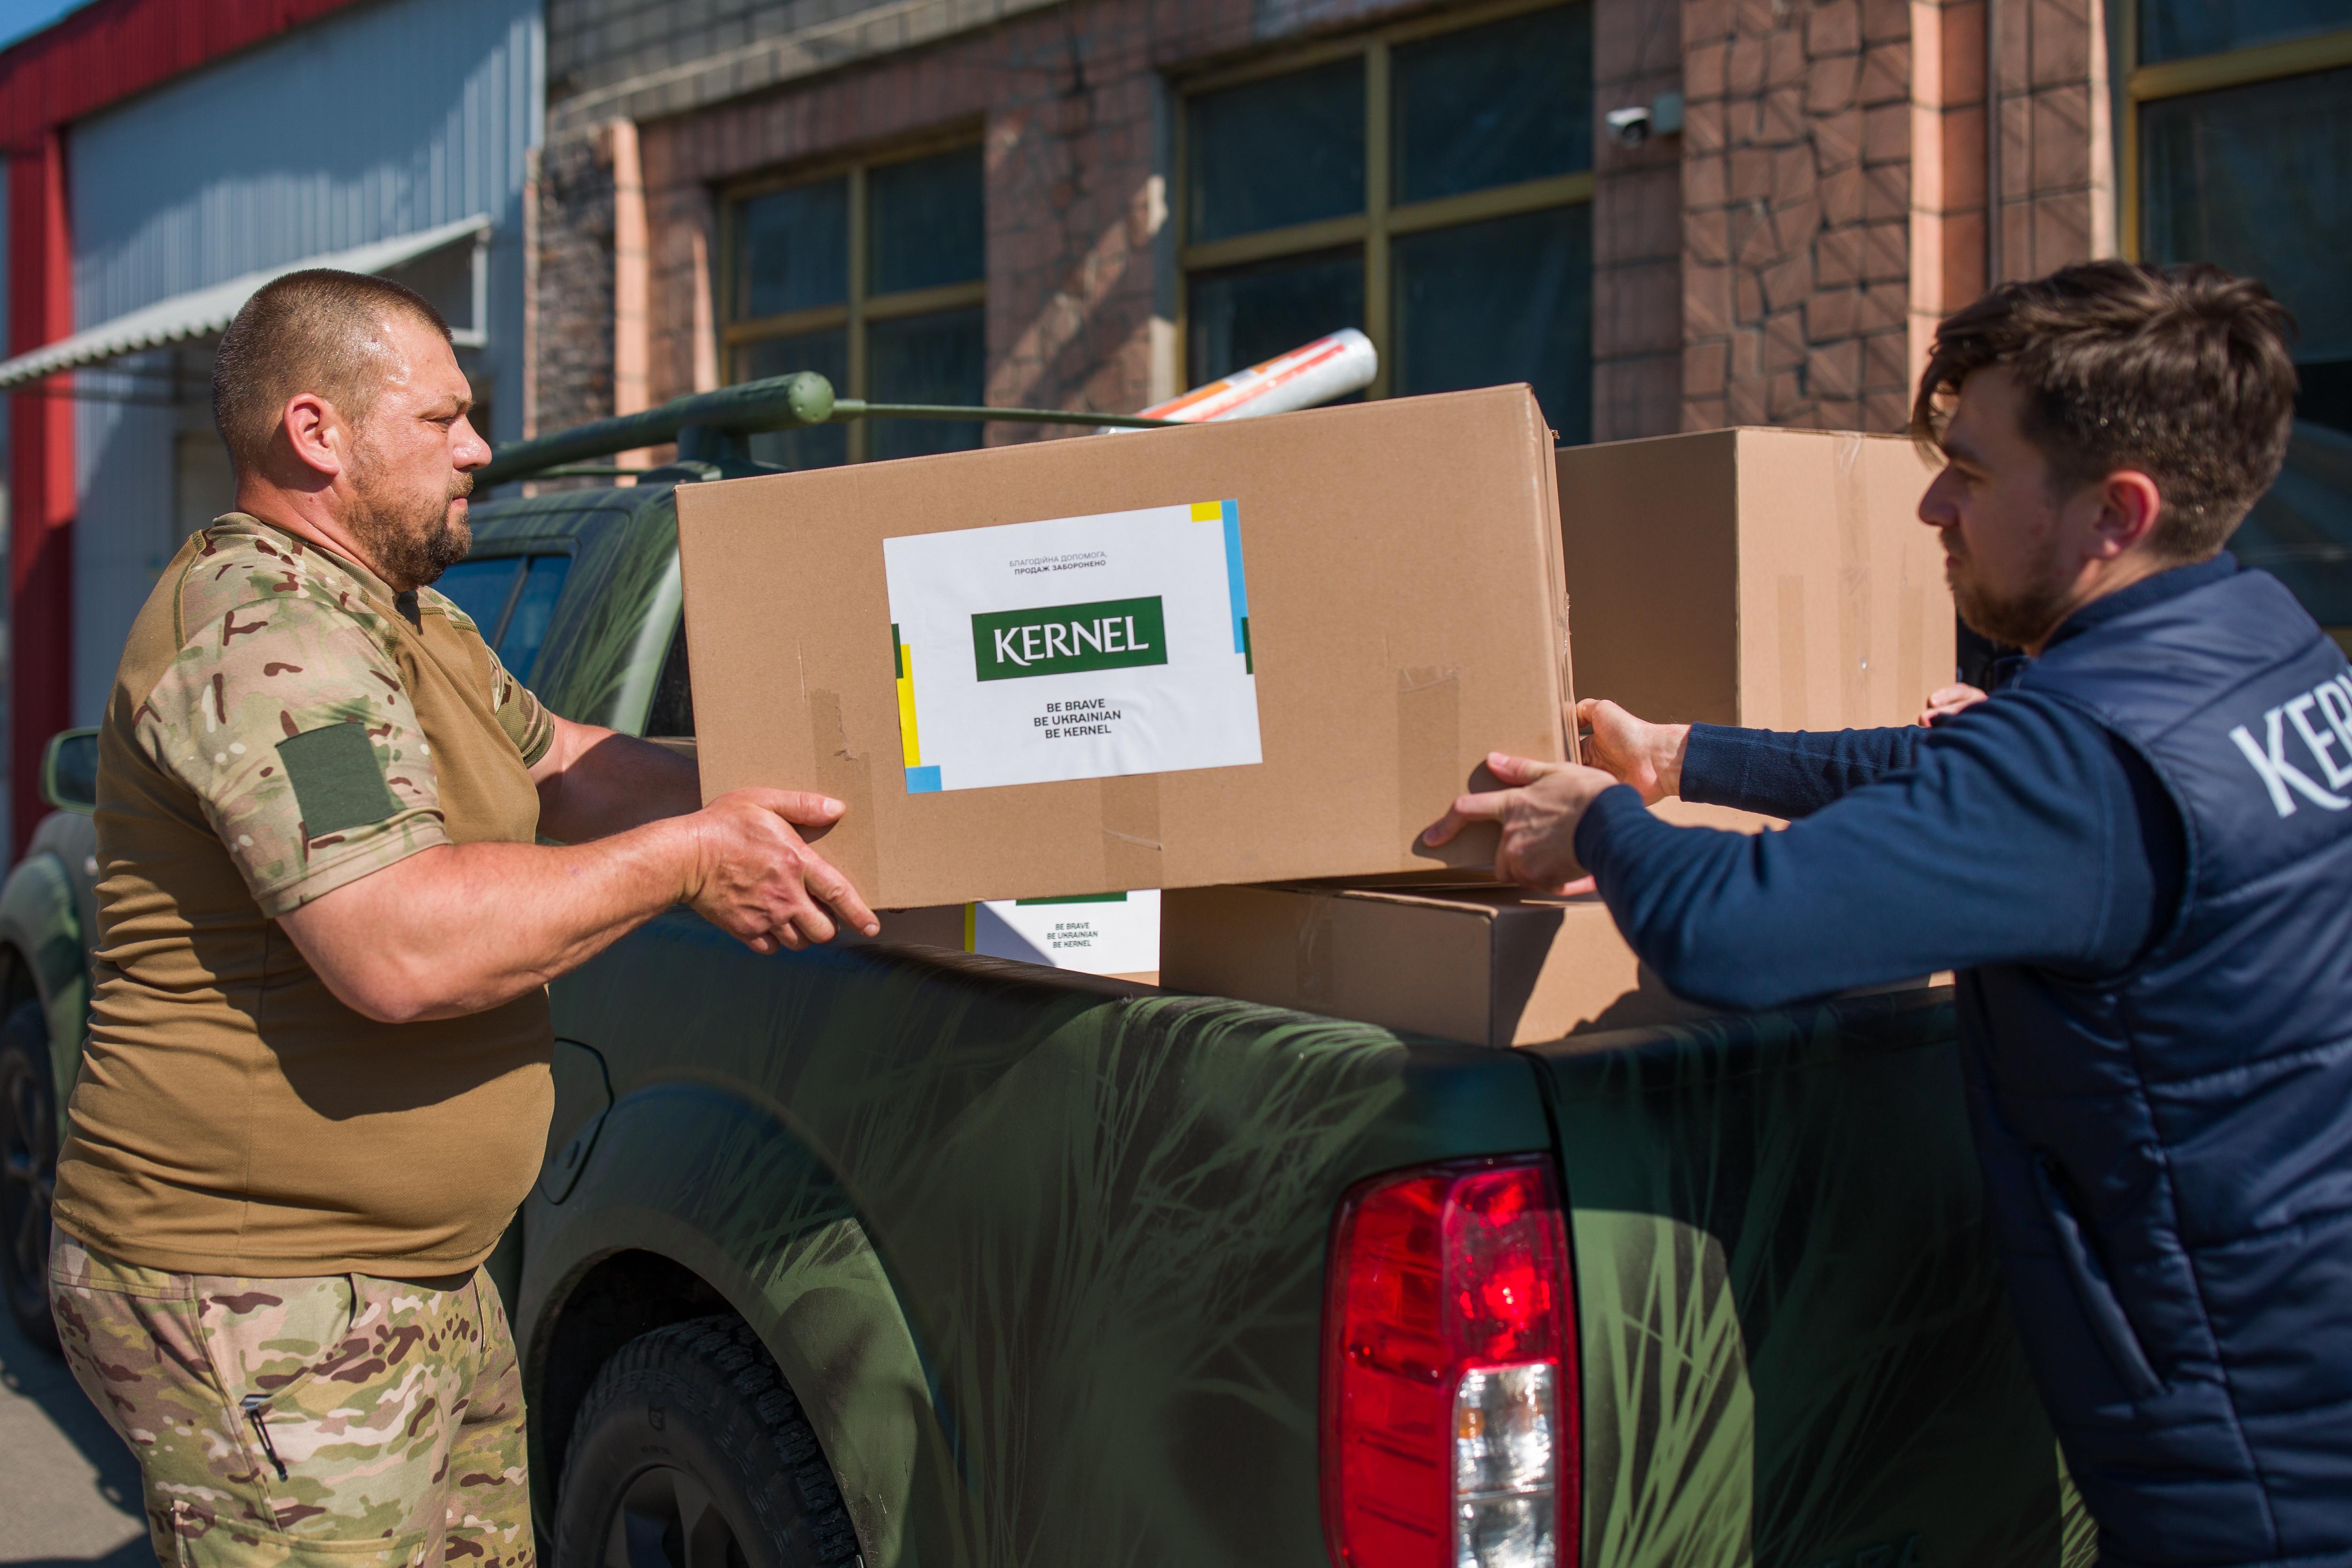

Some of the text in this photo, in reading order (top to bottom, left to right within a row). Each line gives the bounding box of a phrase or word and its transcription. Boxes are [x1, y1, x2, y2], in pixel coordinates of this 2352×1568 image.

[1009, 551, 1108, 567] БЛАГОДІЙНА ДОПОМОГА,
[1014, 560, 1106, 575] ПРОДАЖ ЗАБОРОНЕНО
[994, 615, 1149, 667] KERNEL
[1047, 698, 1105, 713] BE BRAVE
[1034, 710, 1121, 727] BE UKRAINIAN
[1045, 725, 1112, 739] BE KERNEL
[2228, 664, 2352, 819] KER
[1058, 931, 1098, 939] UKRAINIAN
